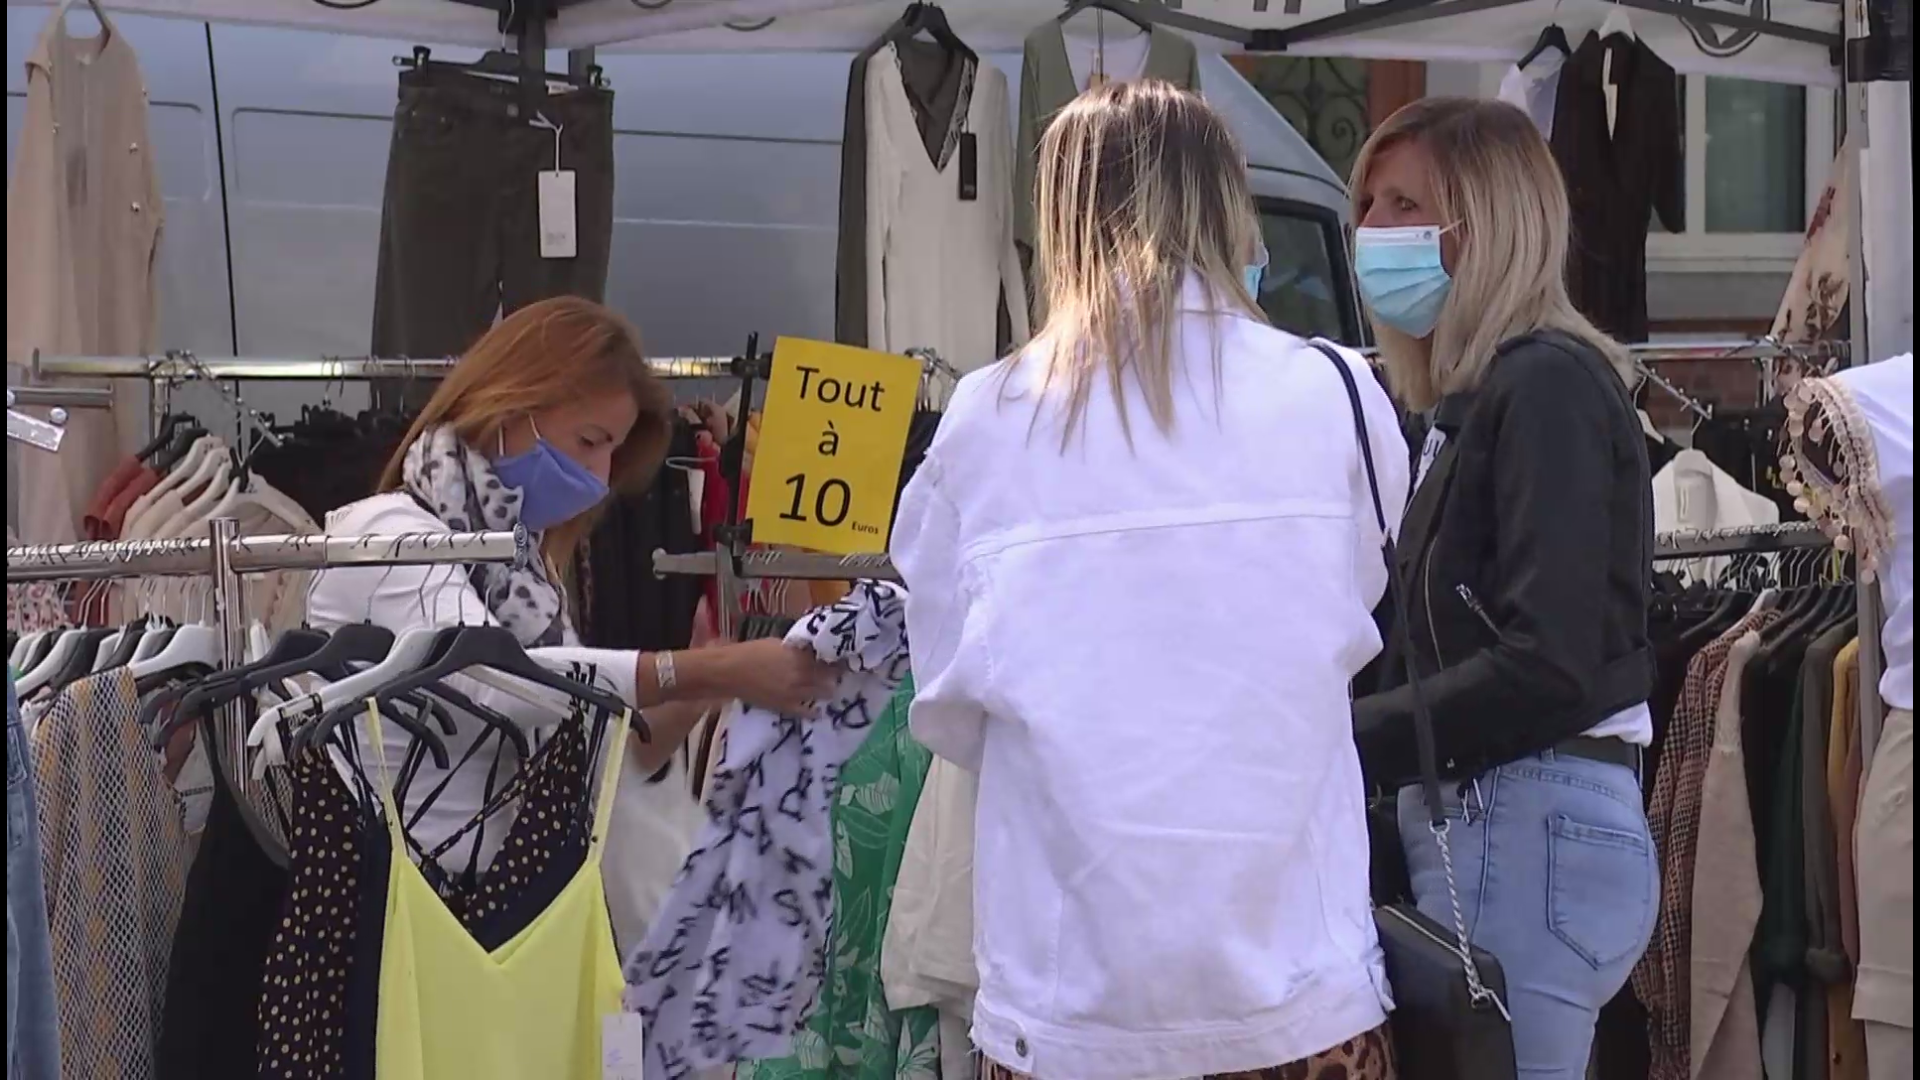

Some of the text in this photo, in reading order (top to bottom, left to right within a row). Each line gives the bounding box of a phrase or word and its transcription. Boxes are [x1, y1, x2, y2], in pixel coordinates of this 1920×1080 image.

[796, 365, 885, 412] Tout
[818, 420, 839, 457] à
[779, 473, 879, 535] 10 Euros
